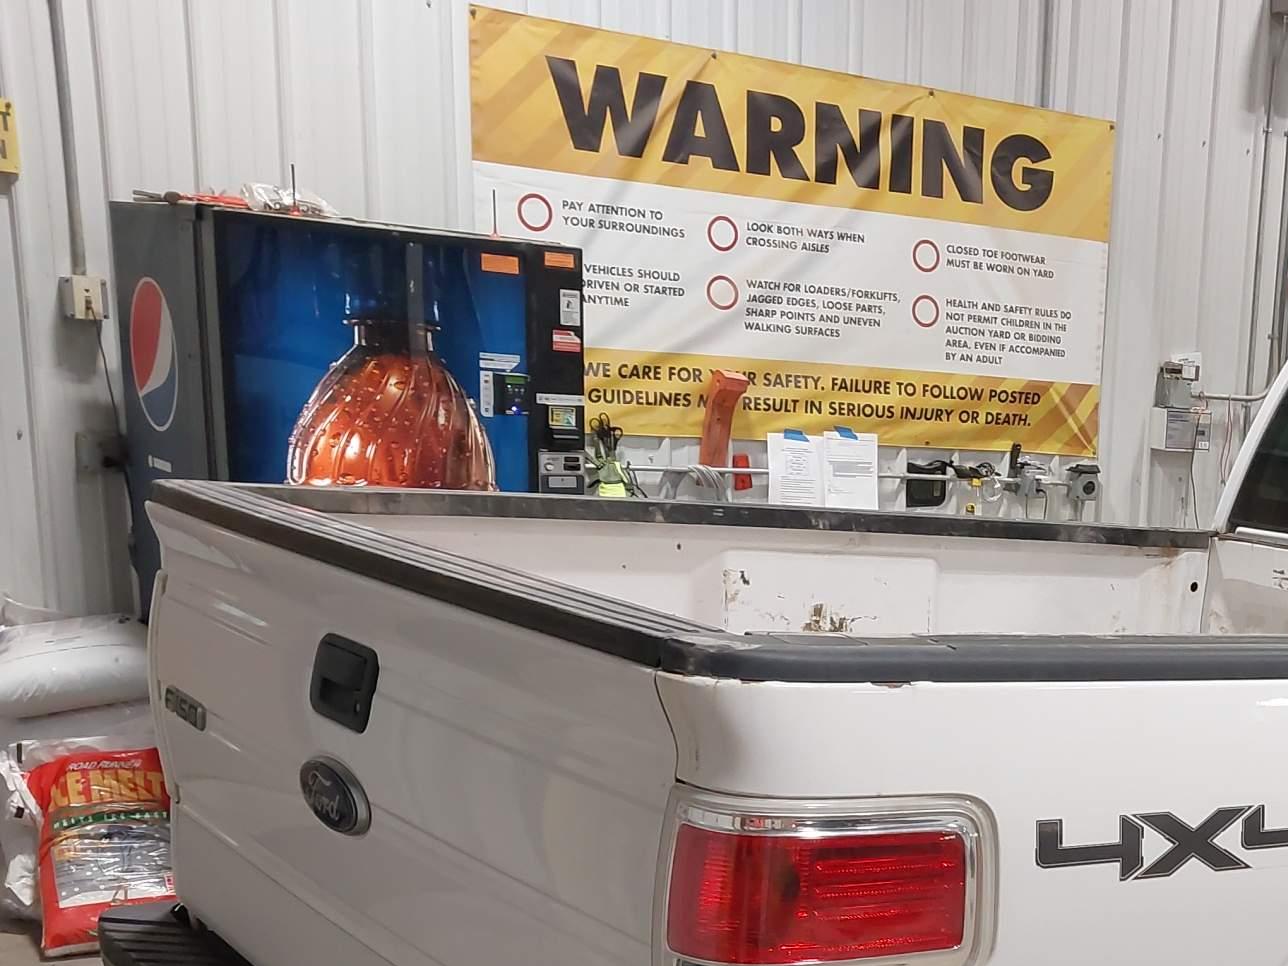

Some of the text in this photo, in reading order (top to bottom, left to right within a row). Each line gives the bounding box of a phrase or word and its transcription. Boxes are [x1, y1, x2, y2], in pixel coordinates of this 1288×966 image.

[545, 55, 1054, 211] WARNING
[562, 200, 663, 221] PAY ATTENTION TO
[563, 215, 685, 238] YOUR SURROUNDINGS
[746, 222, 865, 243] LOOK BOTH WAYS WHEN
[746, 236, 830, 253] CROSSING AISLES
[946, 245, 1046, 265] CLOSED TOE FOOTWEAR
[584, 264, 680, 281] VEHICLES SHOULD
[946, 258, 1054, 279] MUST BE WORN ON YARD
[624, 282, 639, 293] OR
[644, 285, 685, 297] STARTED
[746, 279, 780, 291] WATCH
[783, 282, 801, 293] FOR
[746, 294, 886, 316] JAGGED EDGES, LOOSE PARTS,
[946, 299, 1072, 320] HEALTH AND SAFETY RULES DO
[745, 307, 881, 328] SHARP POINTS AND UNEVEN
[946, 312, 1067, 332] NOT PERMIT CHILDREN IN THE
[744, 321, 841, 338] WALKING SURFACES
[945, 326, 1061, 345] AUCTION YARD OR BIDDING
[945, 352, 1003, 365] BY AN ADULT
[974, 341, 996, 351] EVEN
[999, 344, 1006, 352] IF
[1008, 345, 1066, 358] ACCOMPANIED
[584, 362, 610, 378] WE
[618, 364, 661, 381] CARE
[668, 367, 703, 383] FOR
[762, 372, 825, 391] SAFETY.
[831, 377, 891, 395] FAILURE
[896, 382, 917, 397] TO
[922, 384, 984, 401] FOLLOW
[988, 388, 1041, 406] POSTED
[588, 388, 692, 408] GUIDELINES
[742, 396, 800, 413] RESULT
[805, 399, 823, 414] IN
[828, 401, 894, 419] SERIOUS
[900, 406, 954, 423] INJURY
[958, 411, 980, 425] OR
[985, 412, 1031, 427] DEATH.
